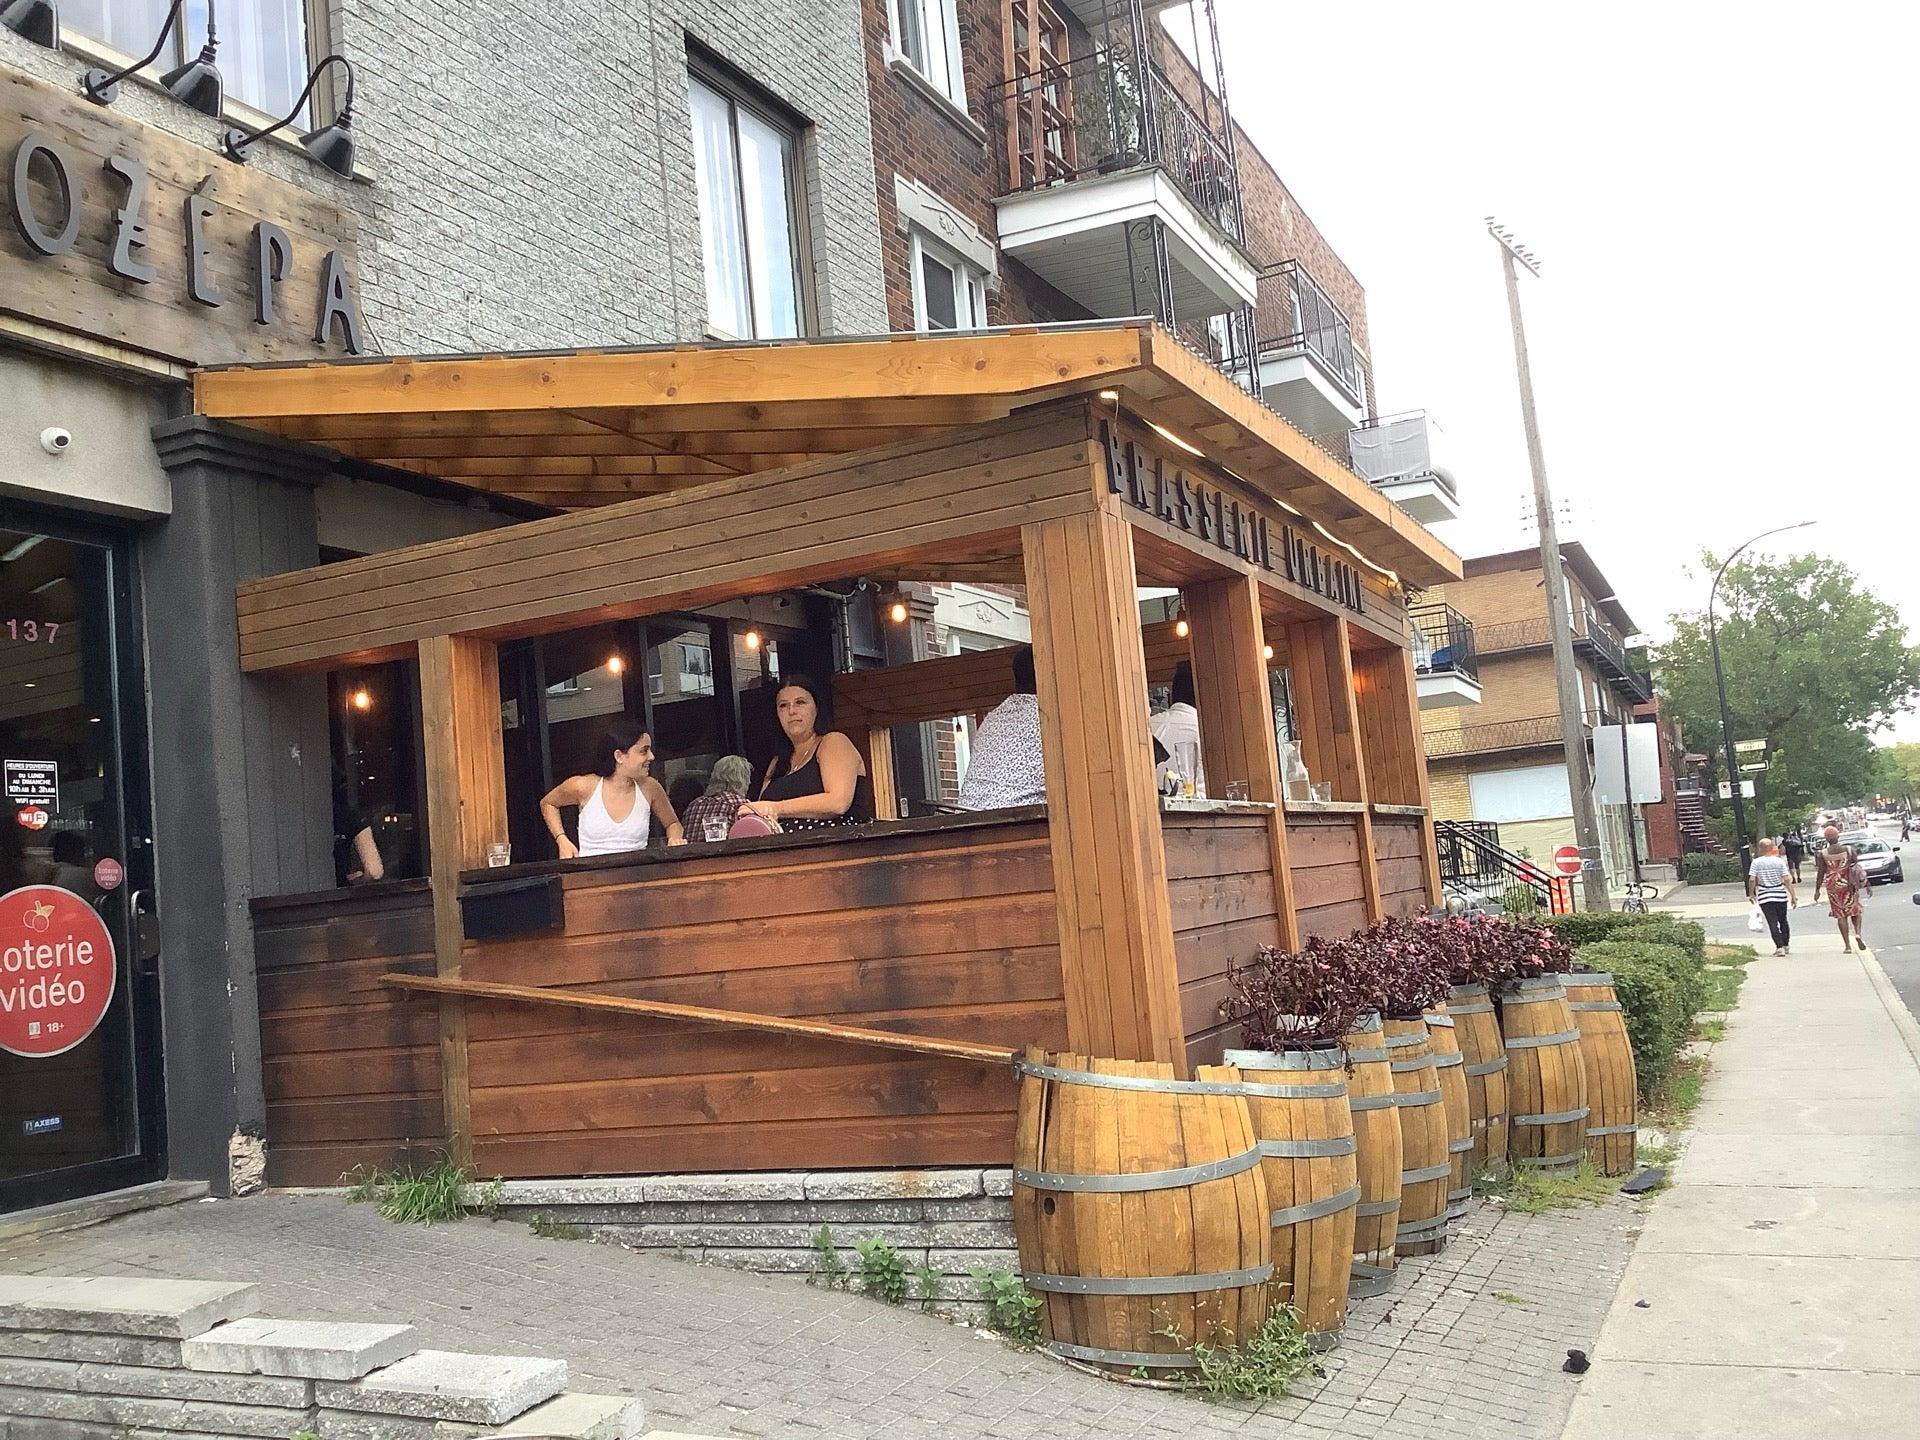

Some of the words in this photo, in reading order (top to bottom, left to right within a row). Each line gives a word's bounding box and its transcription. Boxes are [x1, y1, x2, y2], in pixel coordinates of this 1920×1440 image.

[1101, 419, 1275, 571] BRASSERIE
[1283, 524, 1366, 613] URBAINE
[6, 619, 59, 644] 137
[0, 935, 94, 973] oterie
[0, 973, 86, 1013] vidéo
[46, 1022, 65, 1033] 18+
[34, 1117, 60, 1128] AXESS
